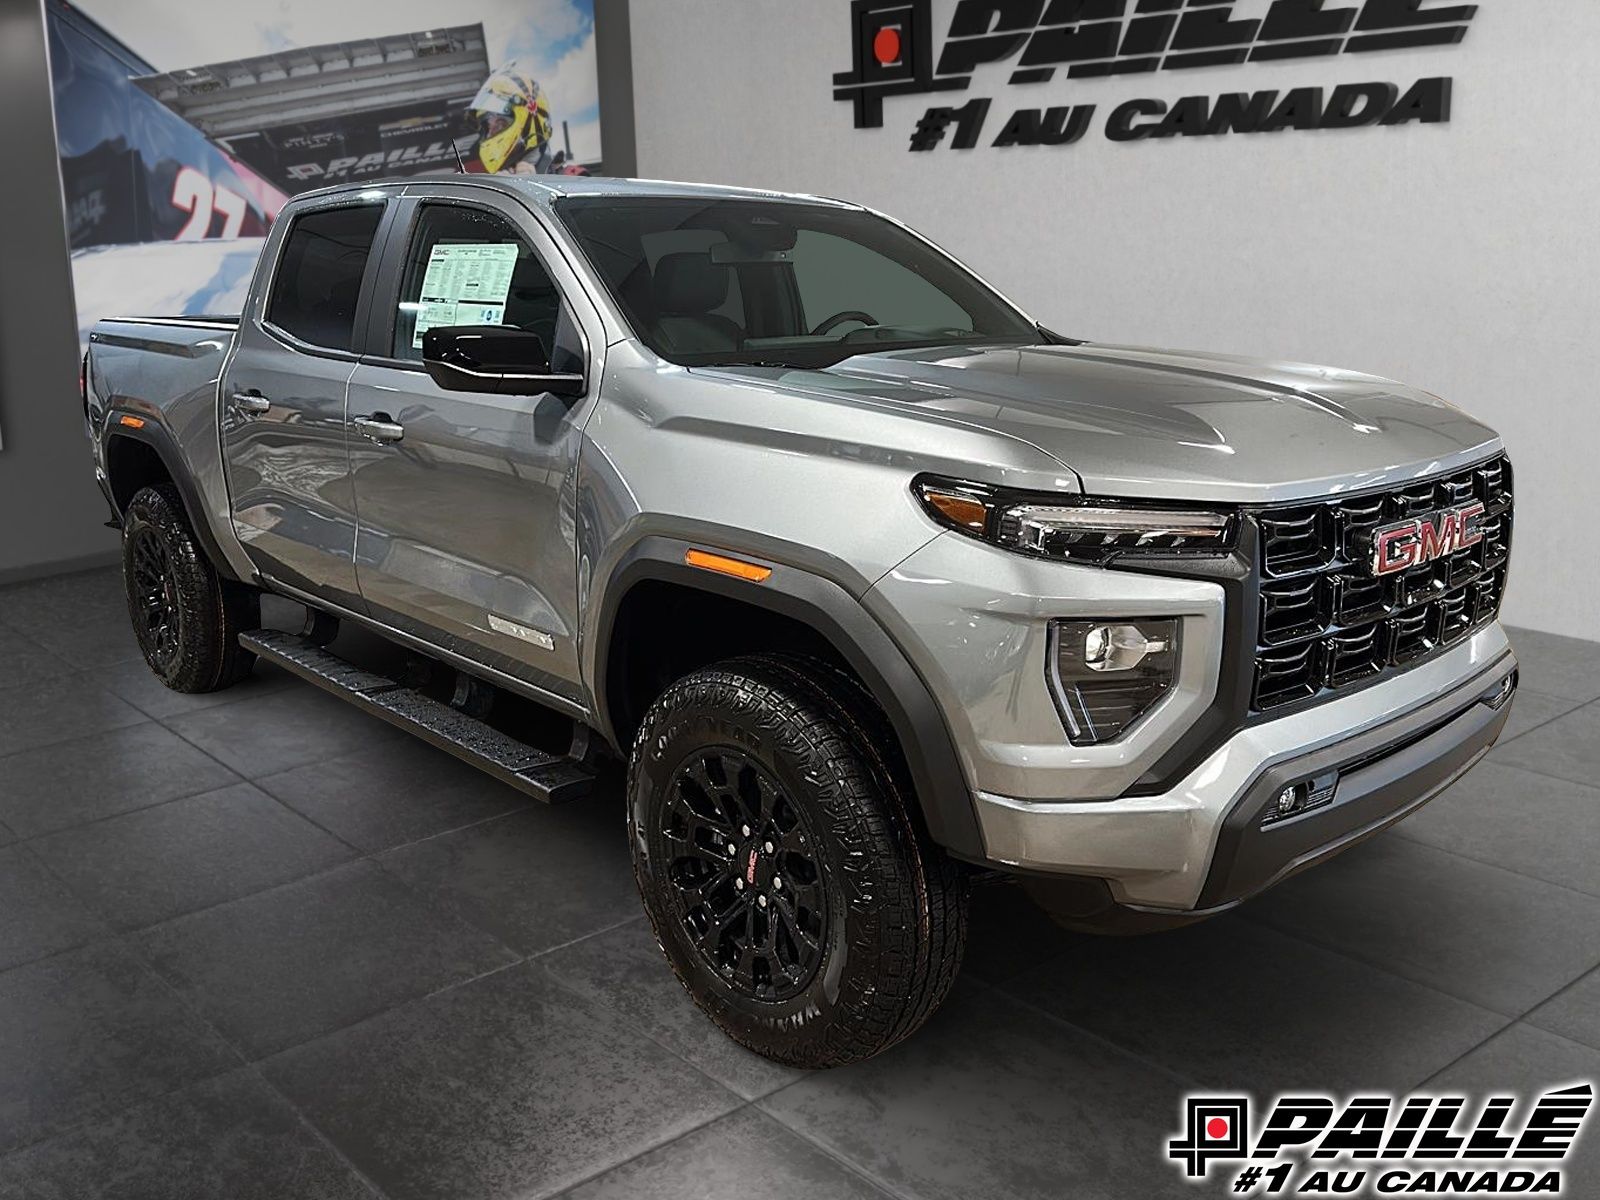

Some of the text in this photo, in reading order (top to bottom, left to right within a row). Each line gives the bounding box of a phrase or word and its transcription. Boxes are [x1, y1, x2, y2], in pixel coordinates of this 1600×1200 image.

[909, 77, 1452, 152] #1 AU CANADA
[171, 165, 248, 240] 27
[1373, 502, 1486, 576] GMC
